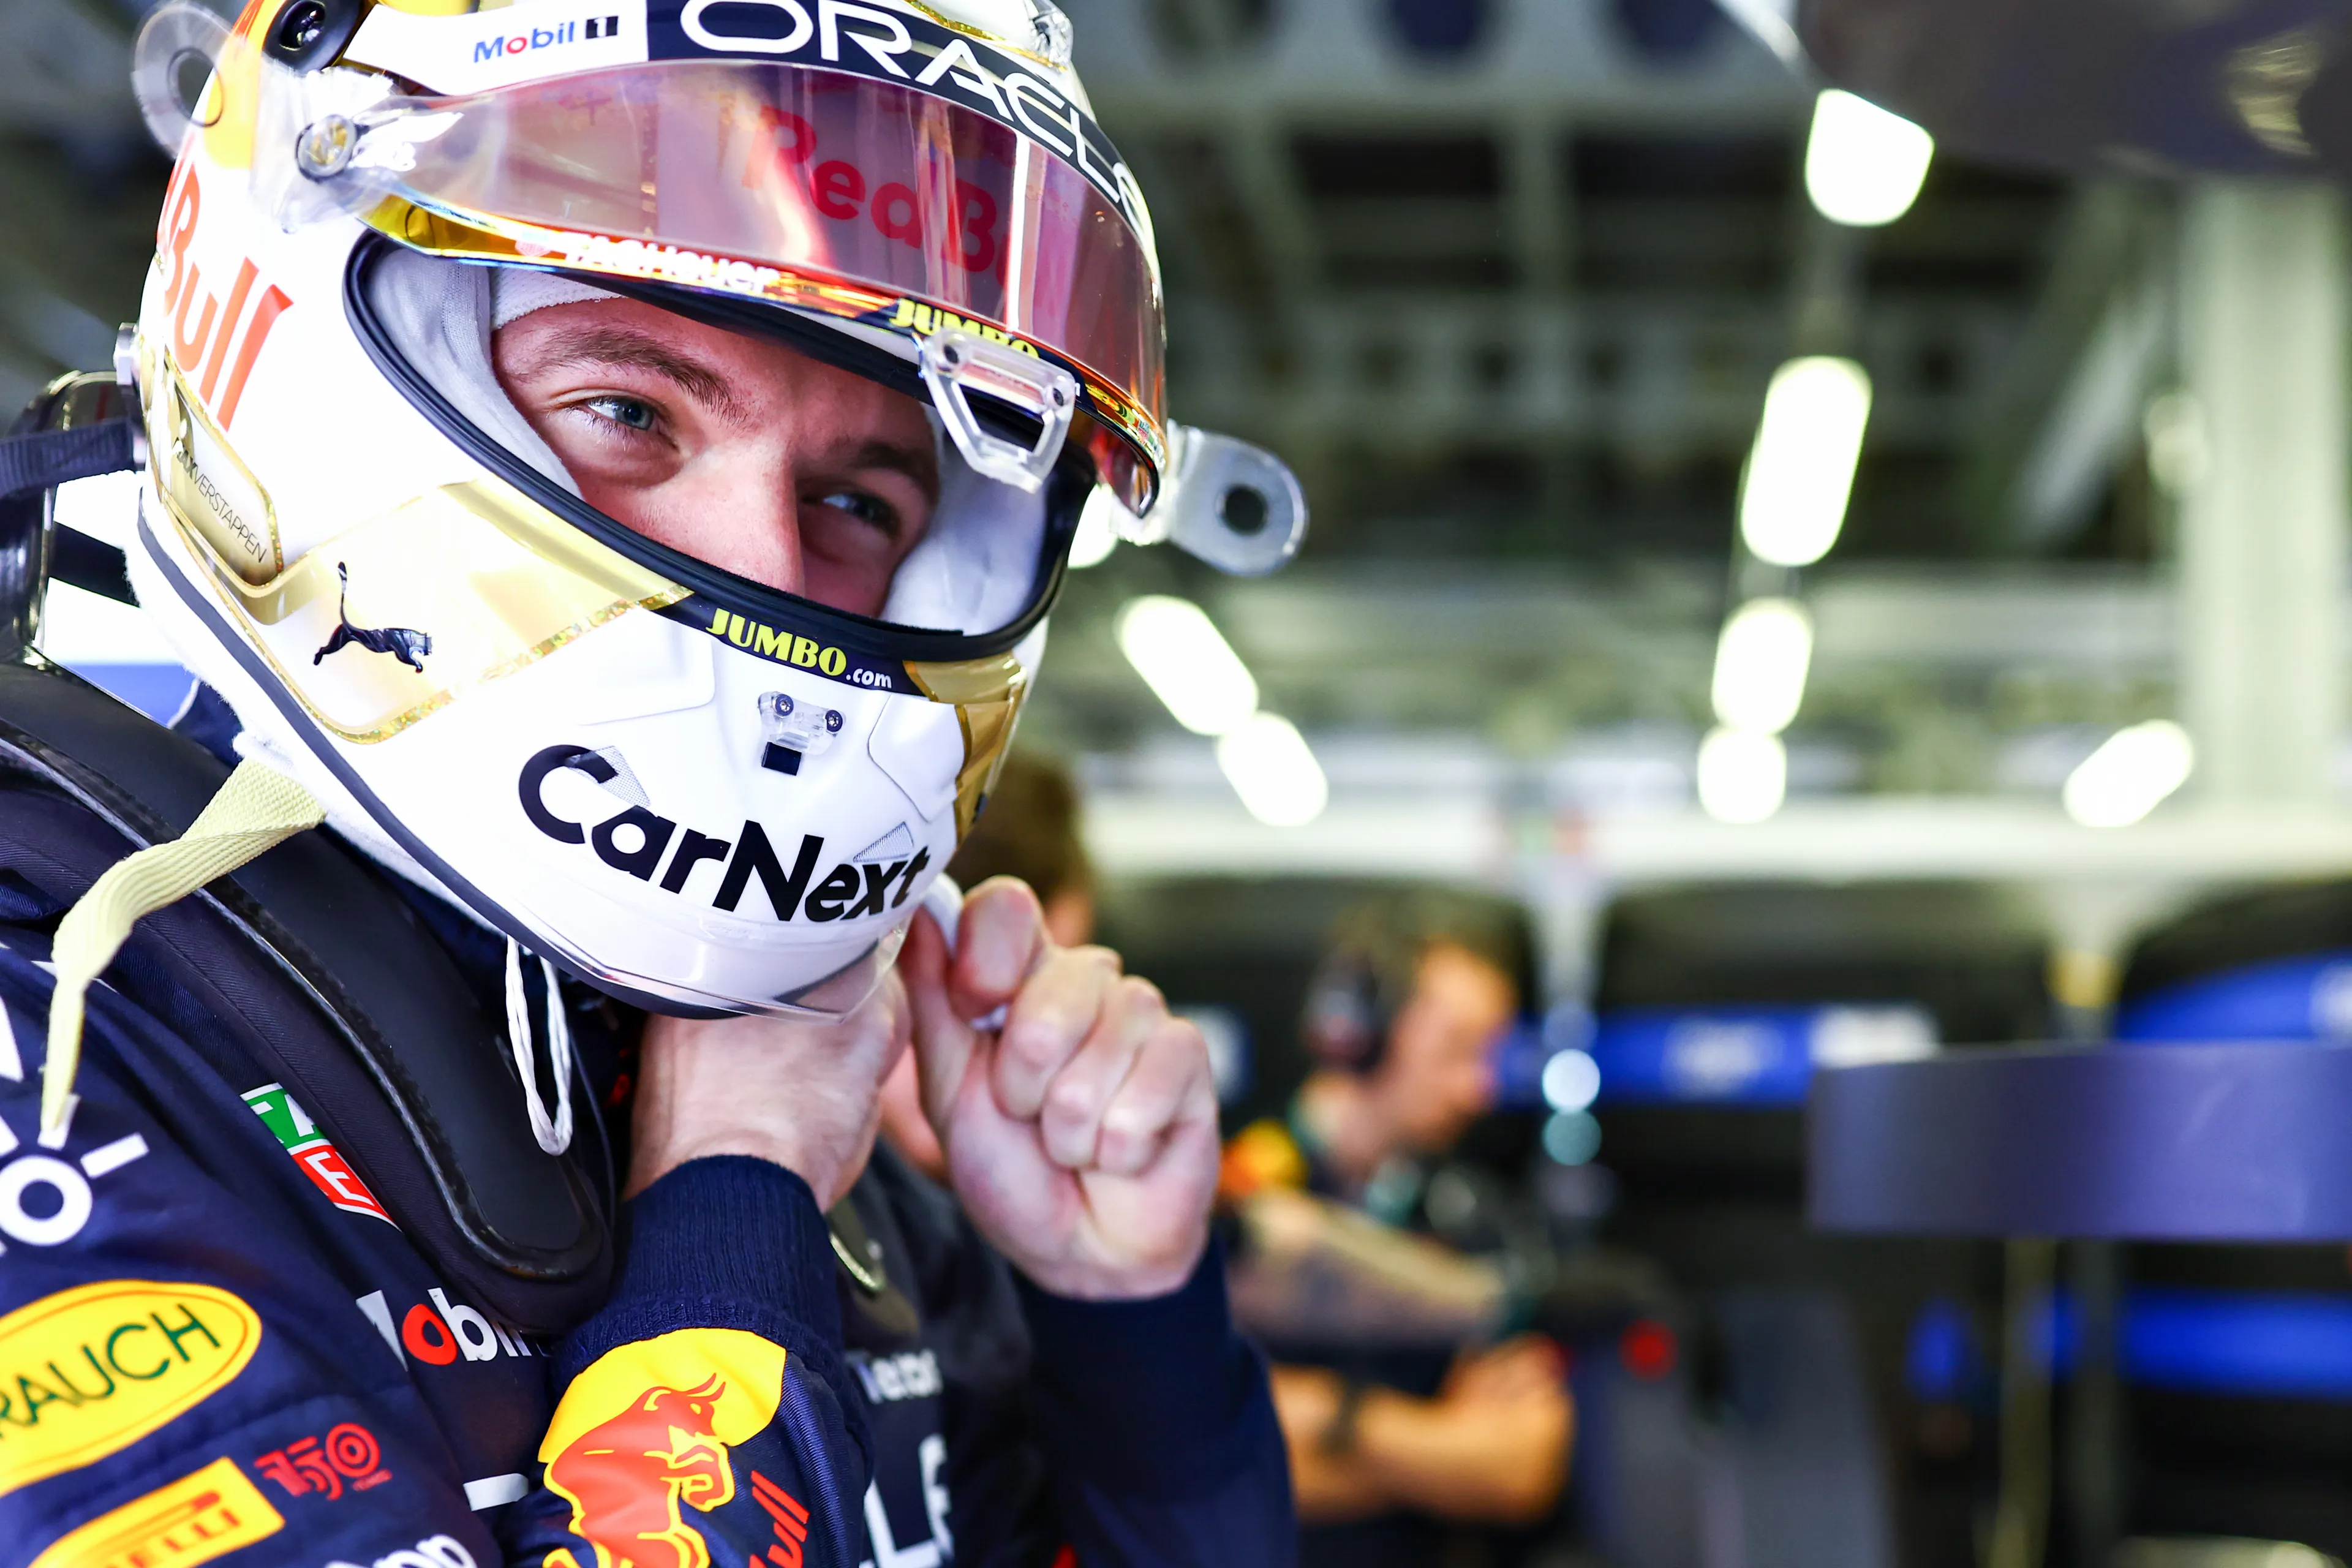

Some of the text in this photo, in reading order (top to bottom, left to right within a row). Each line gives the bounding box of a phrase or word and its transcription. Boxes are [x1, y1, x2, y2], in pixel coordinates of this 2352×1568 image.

[473, 21, 576, 63] Mobil
[518, 744, 931, 922] CarNext
[748, 1470, 810, 1568] ull
